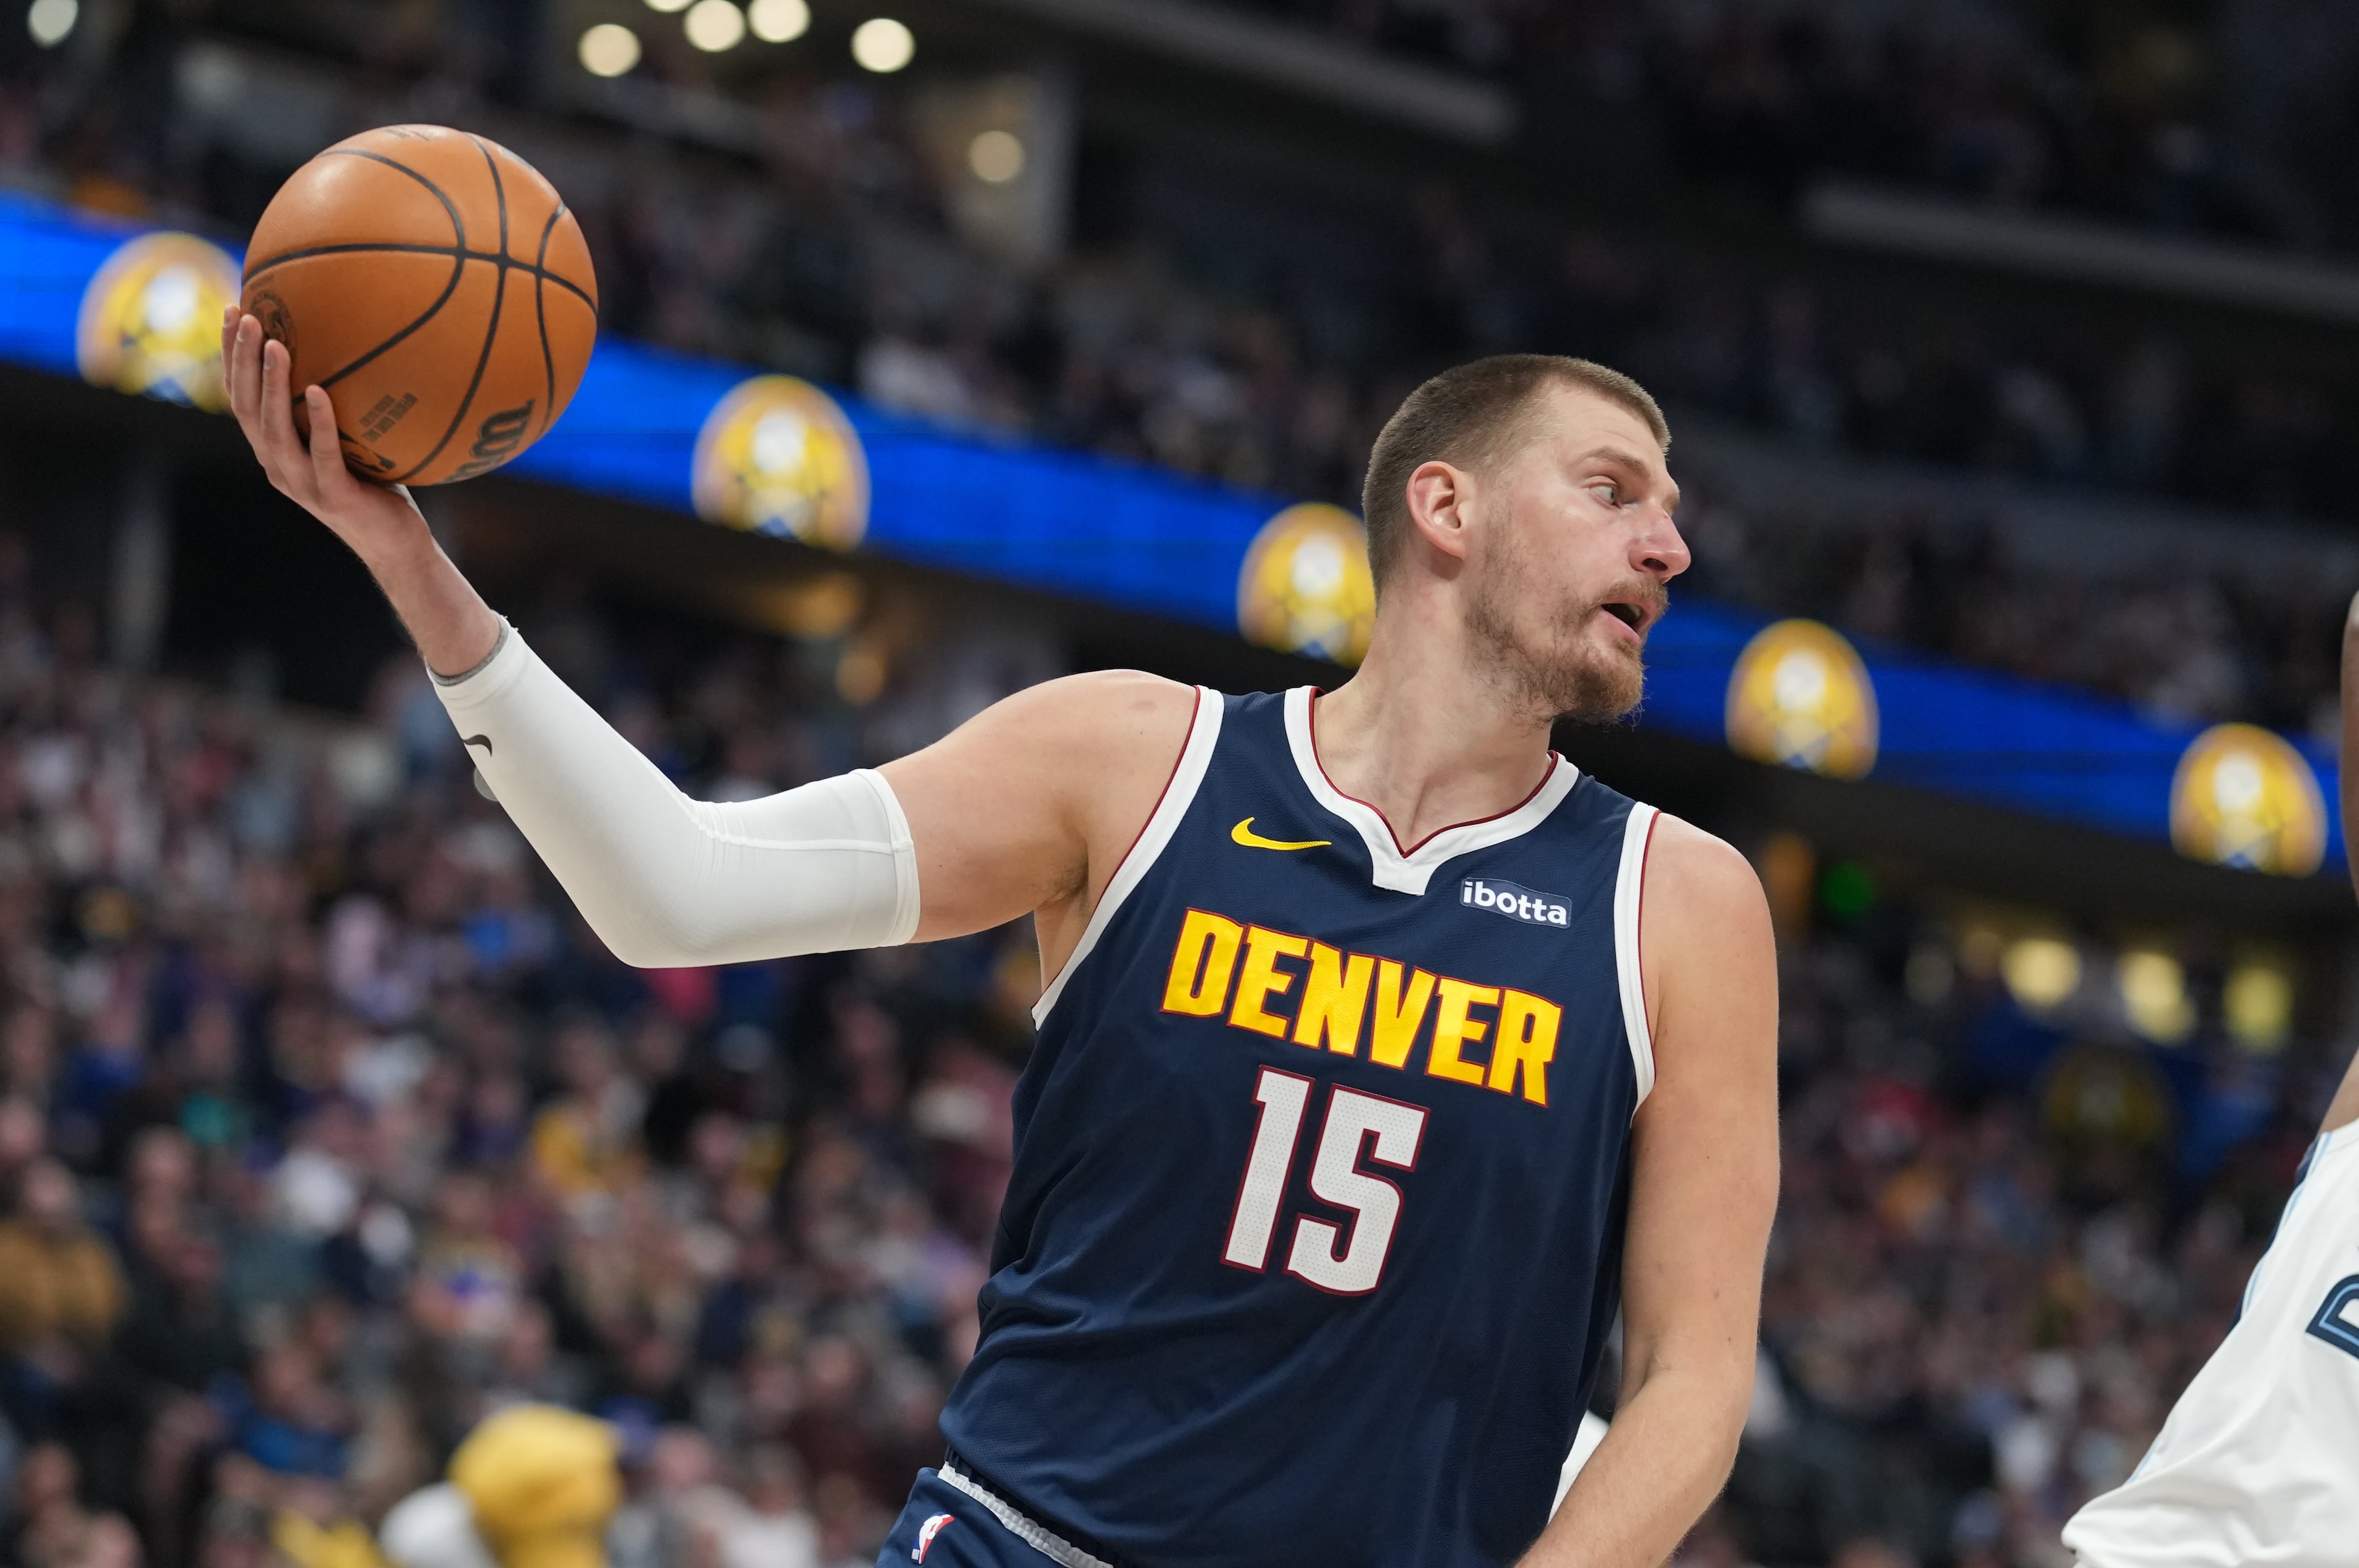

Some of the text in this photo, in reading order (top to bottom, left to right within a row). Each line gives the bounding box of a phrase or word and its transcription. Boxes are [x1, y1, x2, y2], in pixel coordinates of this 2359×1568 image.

[1463, 881, 1567, 925] ibotta
[1160, 907, 1563, 1107] DENVER
[1221, 1065, 1431, 1295] 15
